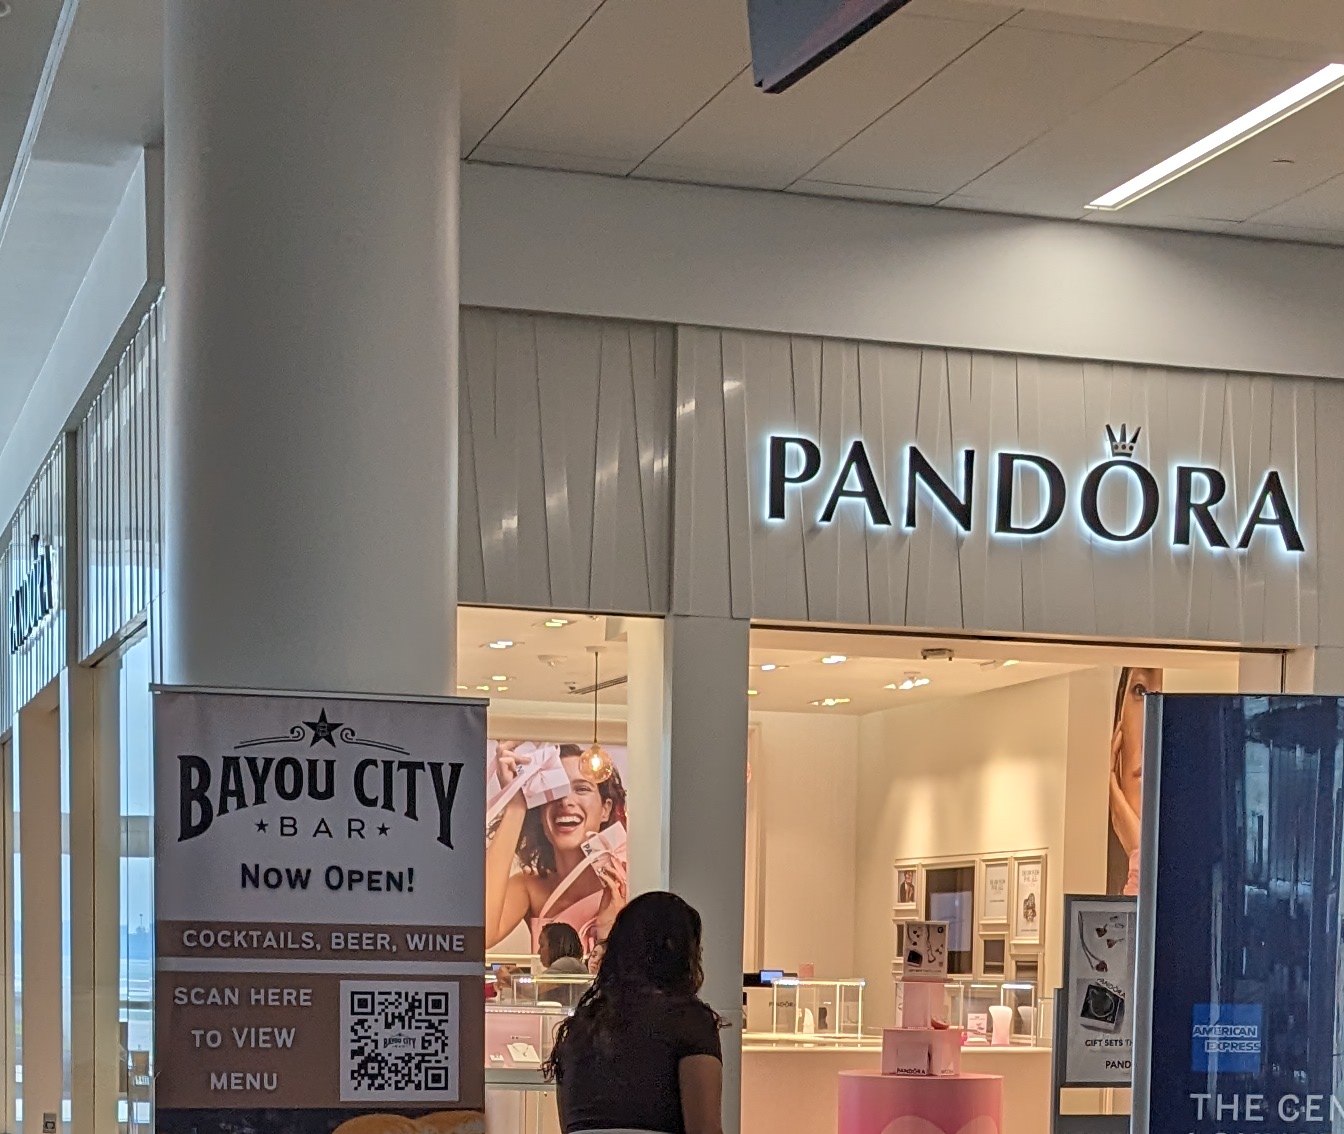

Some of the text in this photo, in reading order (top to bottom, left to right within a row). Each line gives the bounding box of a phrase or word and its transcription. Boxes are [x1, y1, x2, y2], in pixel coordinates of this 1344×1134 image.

[767, 433, 1306, 553] PANDORA
[177, 754, 465, 851] BAYOU CITY
[279, 815, 366, 840] BAR
[240, 862, 415, 893] NOW OPEN!
[182, 928, 465, 953] COCKTAILS, BEER, WINE
[173, 986, 313, 1007] SCAN HERE
[191, 1027, 297, 1049] TO VIEW
[1192, 1024, 1258, 1038] AMERICAN
[1084, 1038, 1103, 1048] GIFT
[1104, 1038, 1124, 1047] SETS
[1204, 1039, 1262, 1053] EXPRESS
[209, 1072, 278, 1091] MENU
[1189, 1092, 1265, 1123] THE
